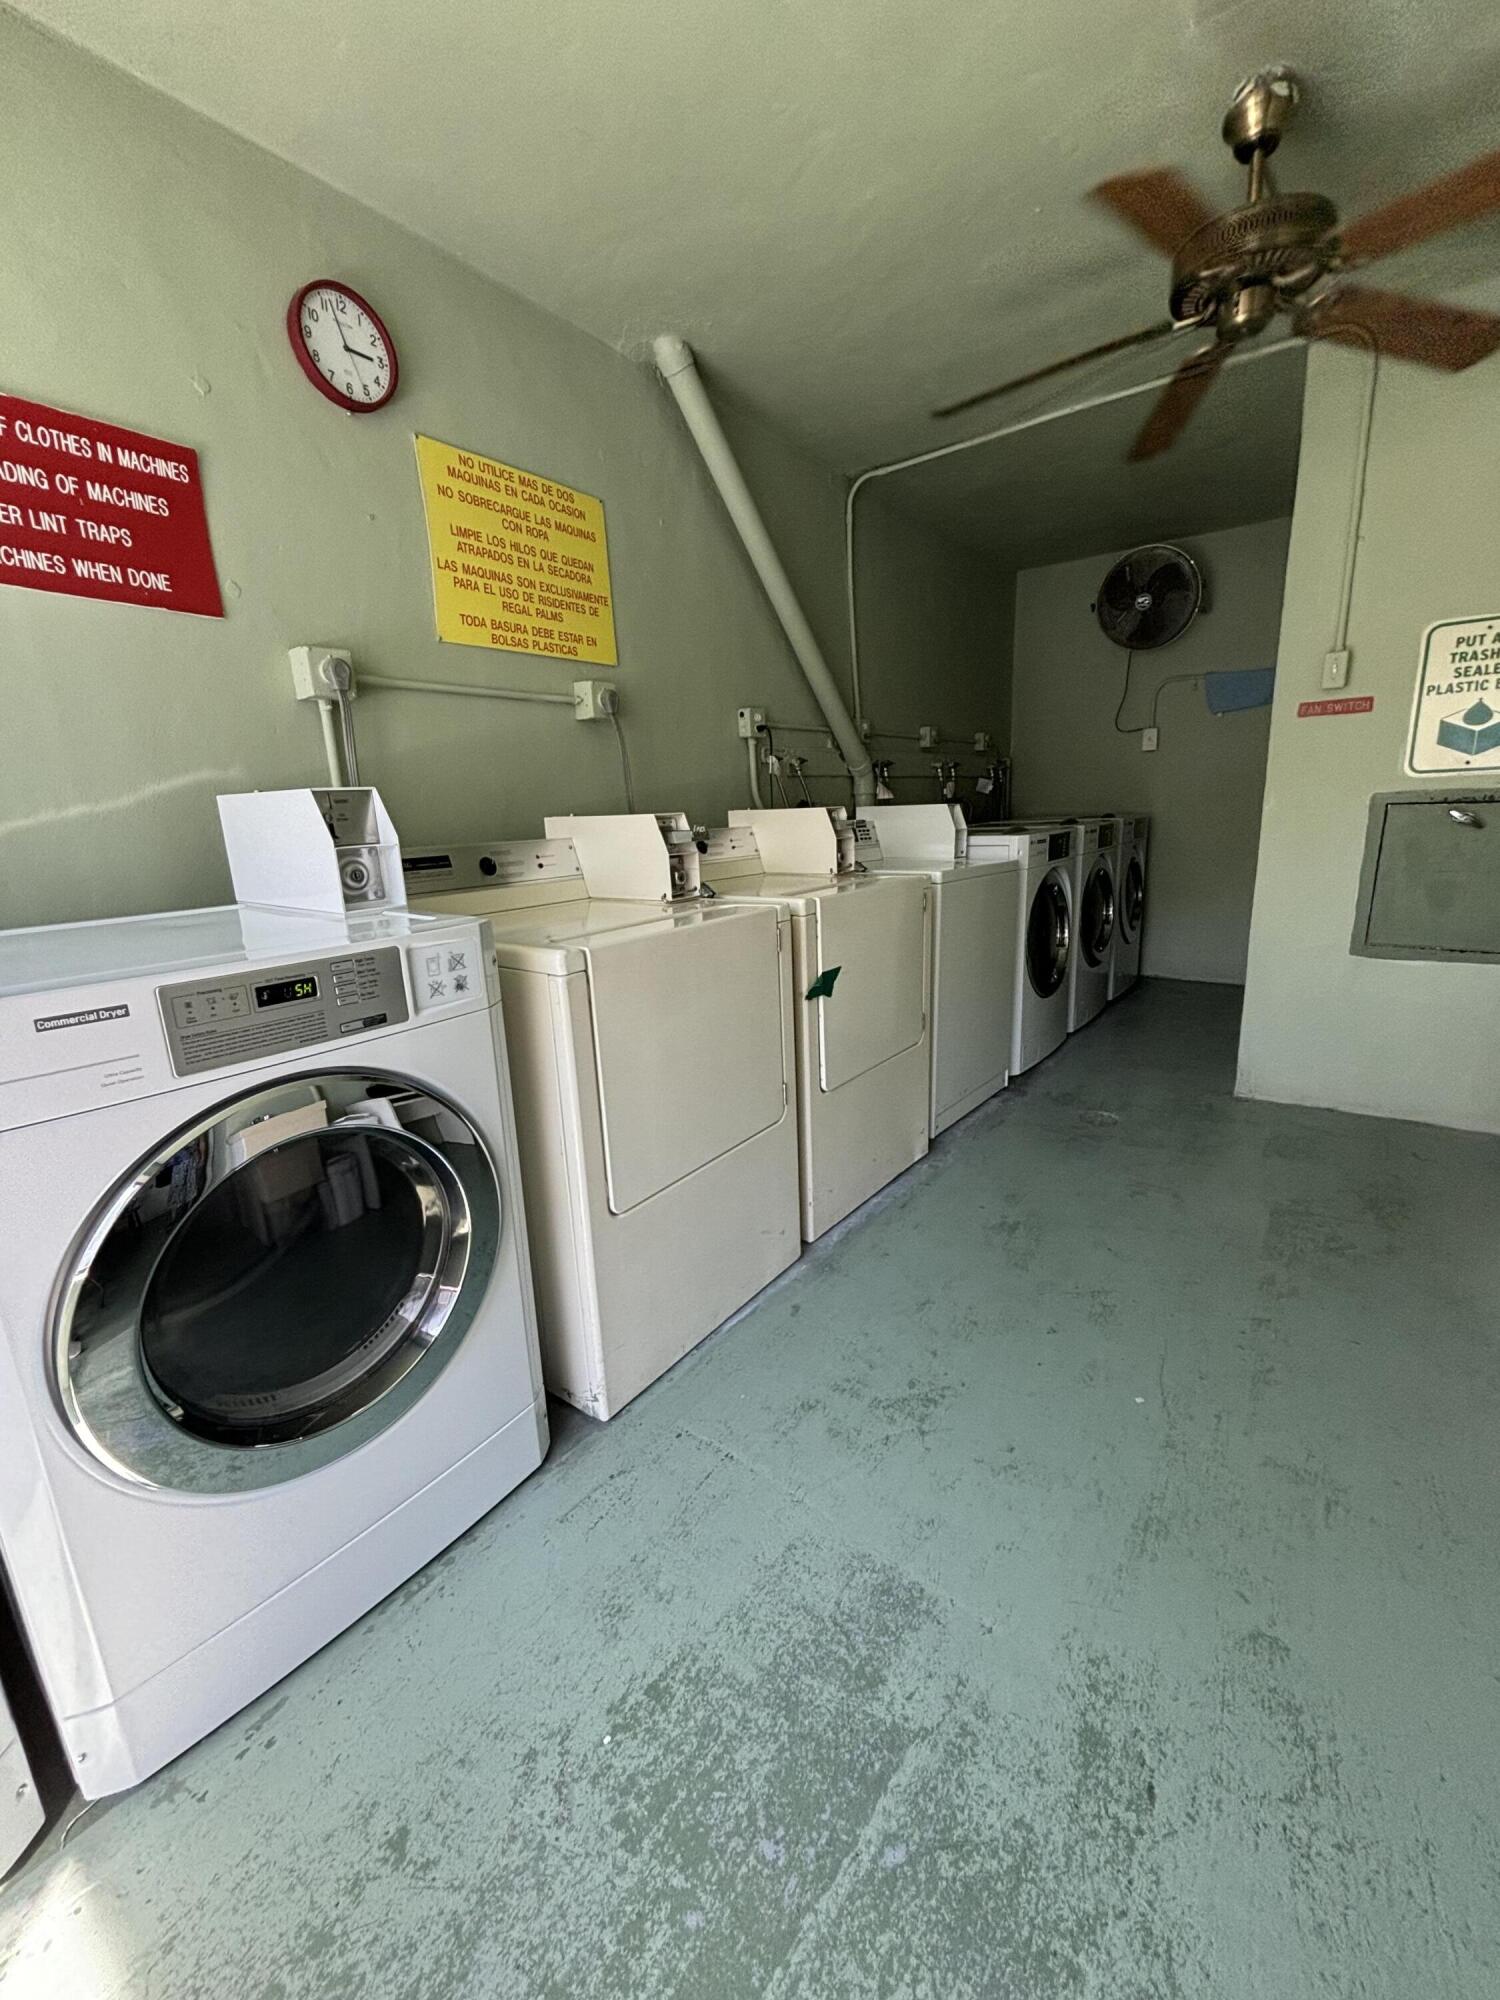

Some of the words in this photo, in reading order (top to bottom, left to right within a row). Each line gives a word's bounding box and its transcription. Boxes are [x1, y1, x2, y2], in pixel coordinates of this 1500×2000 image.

[308, 306, 319, 322] 10
[320, 296, 328, 312] 11
[336, 298, 347, 315] 12
[358, 313, 362, 327] 1
[304, 324, 312, 338] 9
[370, 334, 377, 347] 2
[312, 349, 320, 362] 8
[377, 356, 385, 369] 3
[328, 369, 335, 381] 7
[374, 376, 381, 386] 4
[346, 382, 354, 395] 6
[362, 384, 370, 397] 5
[15, 420, 92, 459] CLOTHES
[96, 441, 113, 464] IN
[117, 448, 190, 484] MACHINES
[458, 454, 474, 469] NO
[478, 460, 515, 483] UTILICE
[518, 474, 539, 492] MAS
[541, 481, 554, 497] DE
[557, 486, 575, 504] DOS
[55, 473, 79, 496] OF
[86, 480, 170, 517] MACHINES
[447, 465, 501, 493] MAQUINAS
[505, 483, 518, 498] EN
[521, 487, 546, 508] CADA
[549, 497, 586, 521] OCASION
[437, 483, 454, 499] NO
[458, 488, 532, 523] SOBRECARGUE
[534, 513, 552, 529] LAS
[554, 519, 597, 543] MAQUINAS
[0, 503, 24, 527] ER
[28, 508, 67, 535] LINT
[75, 518, 133, 548] TRAPS
[501, 518, 523, 535] CON
[526, 524, 550, 542] ROPA
[450, 523, 483, 543] LIMPIE
[486, 533, 507, 549] LOS
[509, 538, 537, 558] HILOS
[540, 547, 558, 563] QUE
[561, 553, 595, 573] QUEDAN
[0, 545, 66, 575] CHINES
[72, 558, 123, 584] WHEN
[127, 568, 173, 593] DONE
[457, 541, 514, 566] ATRAPADOS
[517, 554, 530, 569] EN
[533, 558, 545, 573] LA
[547, 562, 593, 585] SECADORA
[437, 556, 458, 573] LAS
[462, 561, 514, 585] MAQUINAS
[517, 574, 537, 591] SON
[539, 580, 609, 608] EXCLUSIVAMENTE
[453, 576, 480, 593] PARA
[483, 582, 496, 596] EL
[499, 586, 519, 600] USO
[522, 590, 535, 604] DE
[538, 594, 587, 615] RISIDENTES
[589, 604, 600, 618] DE
[502, 600, 533, 617] REGAL
[535, 607, 564, 623] PALMS
[459, 613, 488, 629] TODA
[490, 618, 529, 636] BASURA
[532, 623, 555, 639] DEBE
[558, 630, 584, 645] ESTAR
[586, 635, 598, 648] EN
[491, 634, 529, 649] BOLSAS
[532, 639, 579, 657] PLASTICAS
[1456, 633, 1487, 649] PUT
[1449, 647, 1500, 664] TRASH
[1426, 679, 1490, 696] PLASTIC
[1300, 704, 1322, 714] FAN
[1327, 700, 1370, 713] SWITCH
[36, 1010, 98, 1030] Commercial
[99, 1006, 127, 1020] Dryer
